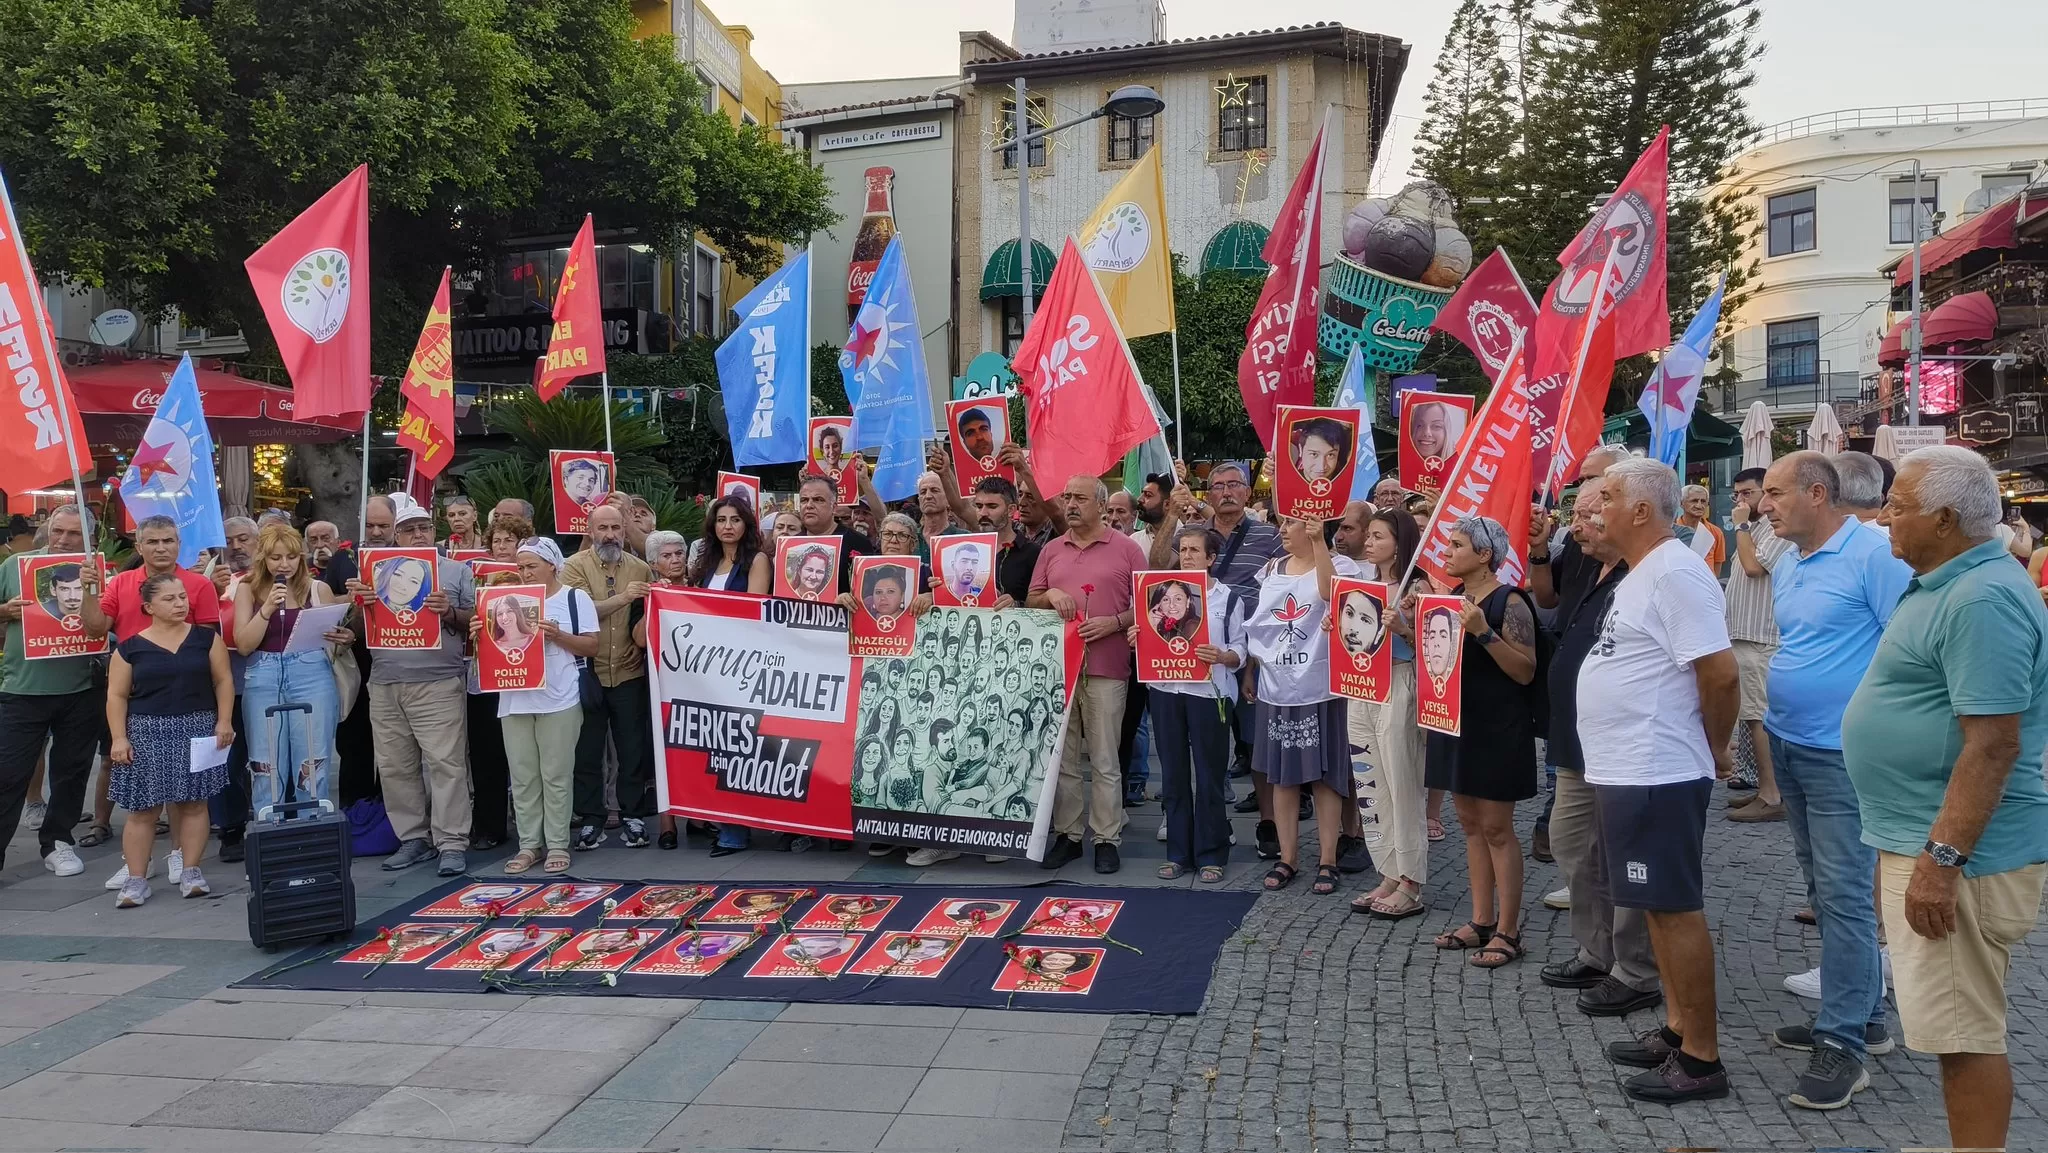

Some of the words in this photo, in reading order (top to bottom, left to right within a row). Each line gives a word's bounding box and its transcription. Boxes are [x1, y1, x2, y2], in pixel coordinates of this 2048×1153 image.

[824, 136, 859, 146] Artimo
[862, 131, 885, 142] Cafe
[524, 326, 539, 350] &
[1294, 498, 1333, 510] UĞUR
[788, 601, 847, 629] YILINDA
[381, 628, 424, 637] NURAY
[855, 634, 908, 647] NAZEGÜL
[48, 644, 87, 656] AKSU
[661, 622, 763, 691] Suruç
[763, 650, 785, 670] için
[858, 646, 903, 656] BOYRAZ
[1151, 658, 1197, 668] DUYGU
[494, 667, 528, 678] POLEN
[1157, 669, 1193, 679] TUNA
[1340, 672, 1375, 687] VATAN
[498, 676, 526, 688] ÜNLÜ
[749, 668, 846, 712] ADALET
[1340, 684, 1377, 700] BUDAK
[1424, 700, 1450, 716] VEYSEL
[1421, 709, 1454, 731] ÖZDEMİR
[669, 704, 755, 754] HERKES
[710, 751, 729, 773] için
[726, 736, 811, 798] adalet
[855, 818, 900, 837] ANTALYA
[901, 823, 931, 841] EMEK
[934, 826, 953, 842] VE
[950, 828, 1013, 850] DEMOKRASİ
[1020, 985, 1062, 993] METE
